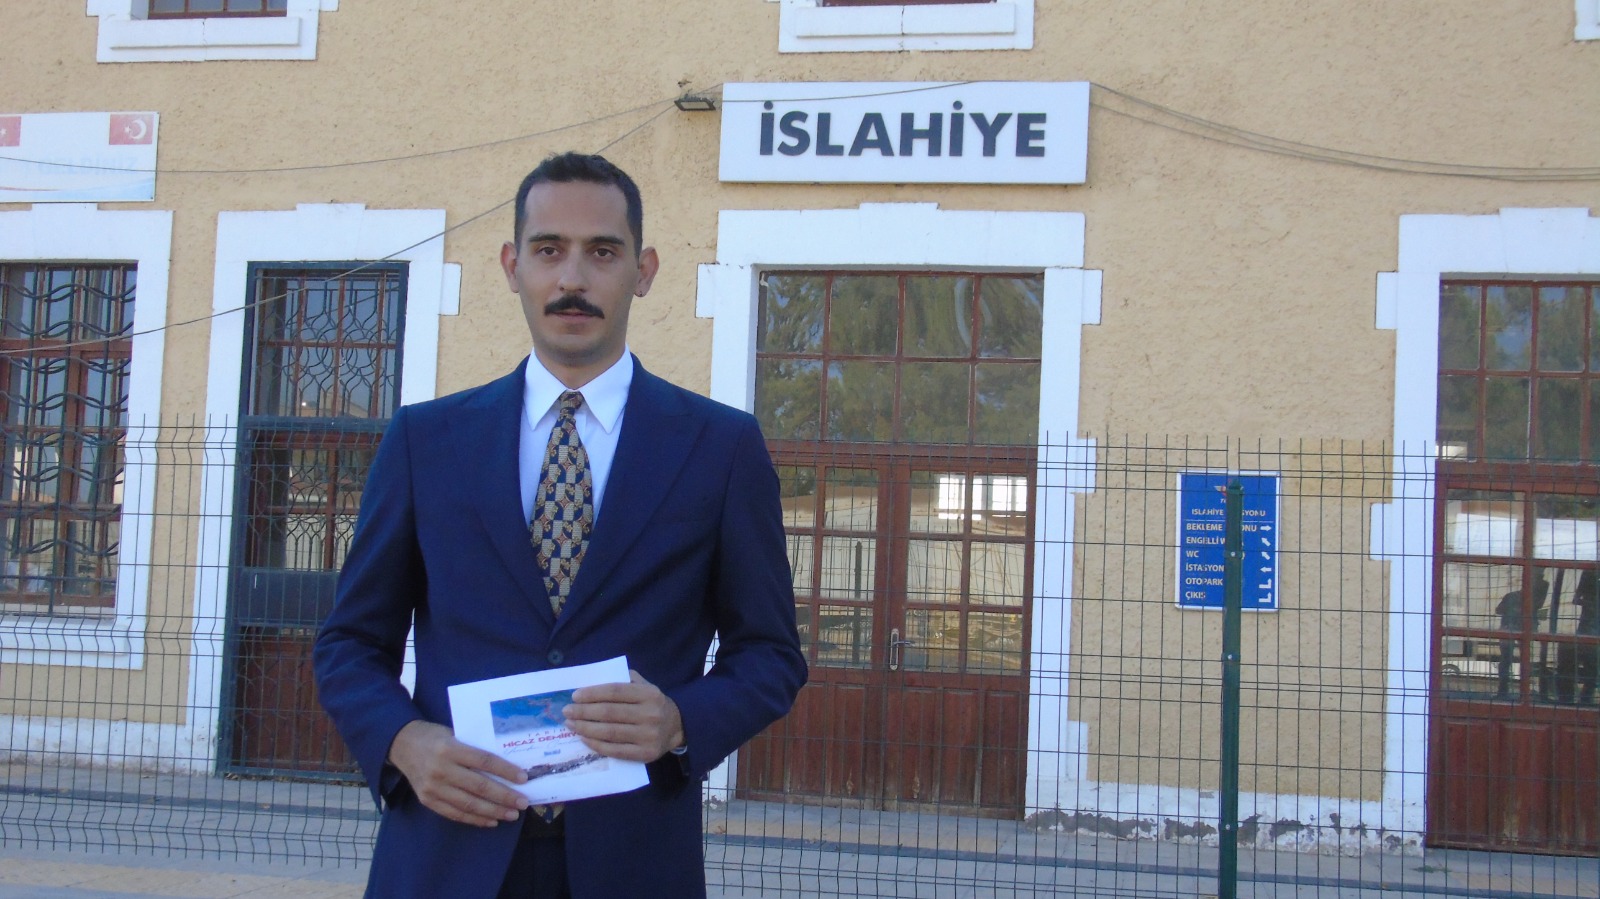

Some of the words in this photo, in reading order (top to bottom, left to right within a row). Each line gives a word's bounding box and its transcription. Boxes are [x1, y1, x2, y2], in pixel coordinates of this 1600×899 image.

[760, 100, 1047, 157] İSLAHİYE
[1186, 523, 1223, 531] BEKLEME
[1186, 536, 1219, 545] ENGELLİ
[1186, 550, 1199, 558] WC
[1185, 563, 1225, 572] İSTASYON
[1185, 577, 1223, 586] OTOPARK
